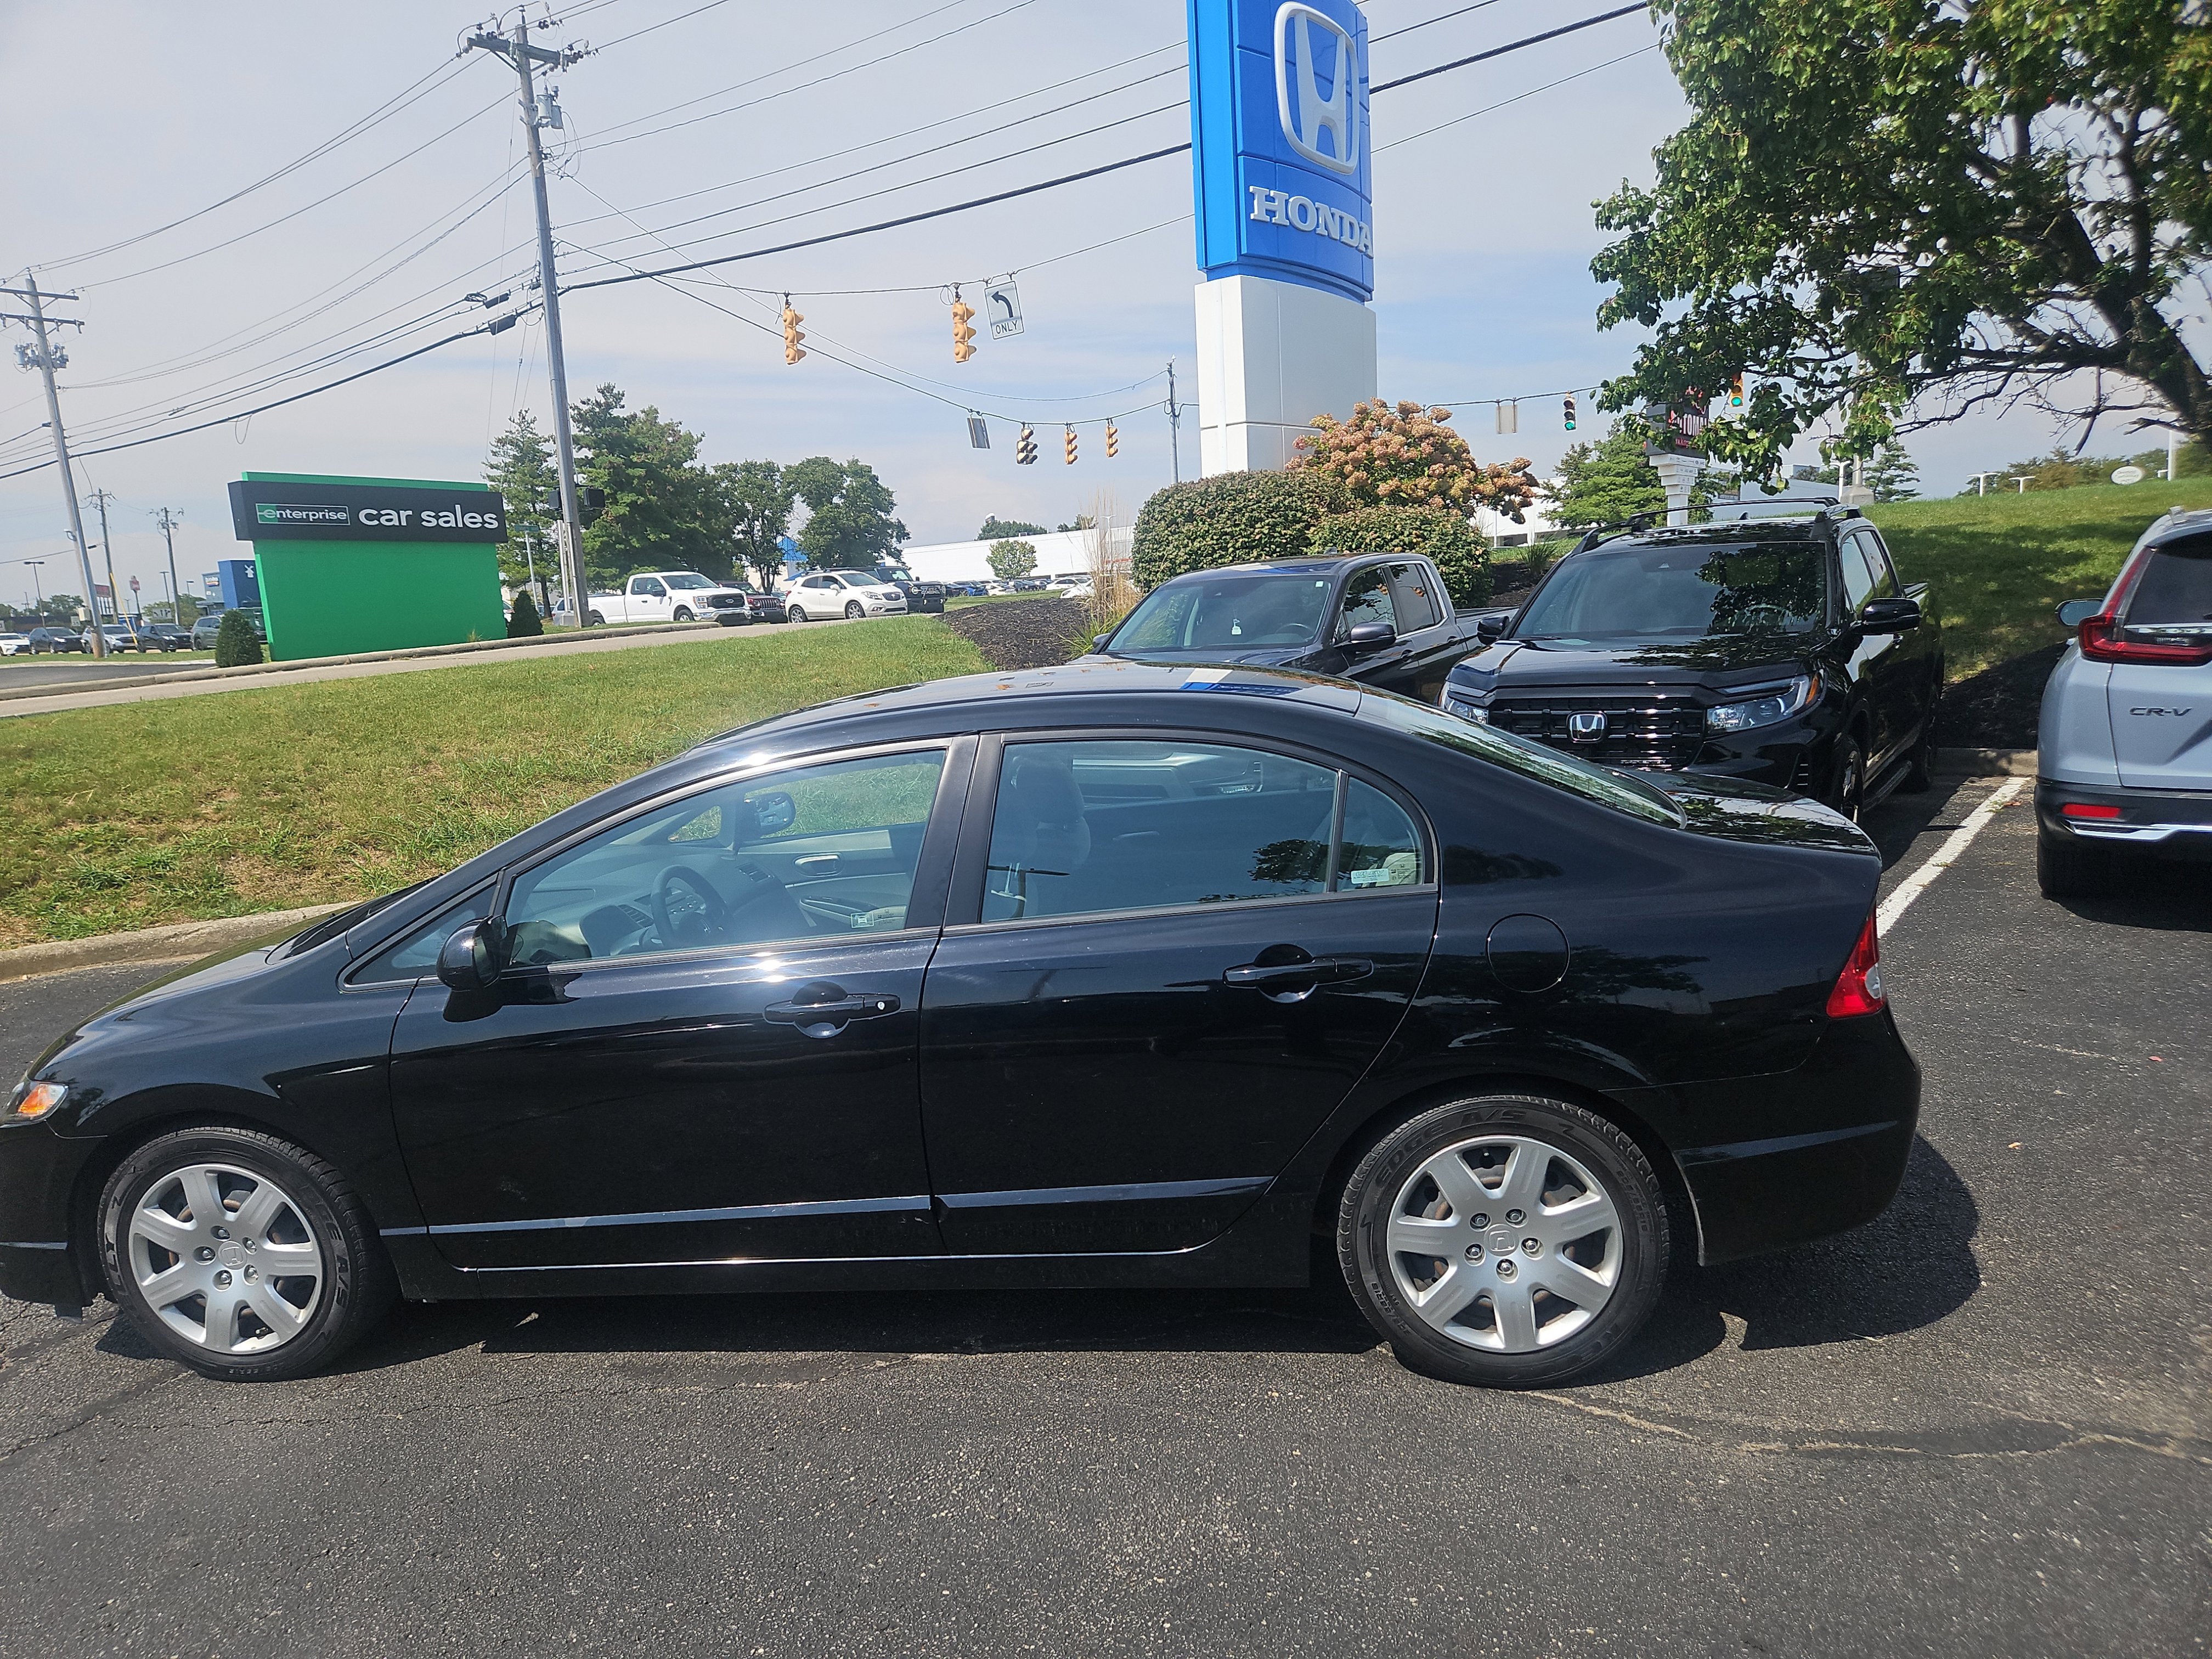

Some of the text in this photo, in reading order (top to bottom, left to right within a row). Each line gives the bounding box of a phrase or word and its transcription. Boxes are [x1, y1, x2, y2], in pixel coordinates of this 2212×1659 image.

[1249, 185, 1374, 259] HONDA
[995, 319, 1018, 334] ONLY
[263, 505, 499, 529] enterprise car sales
[2129, 706, 2193, 716] CR-V
[1375, 1109, 1527, 1187] EDGE A/S
